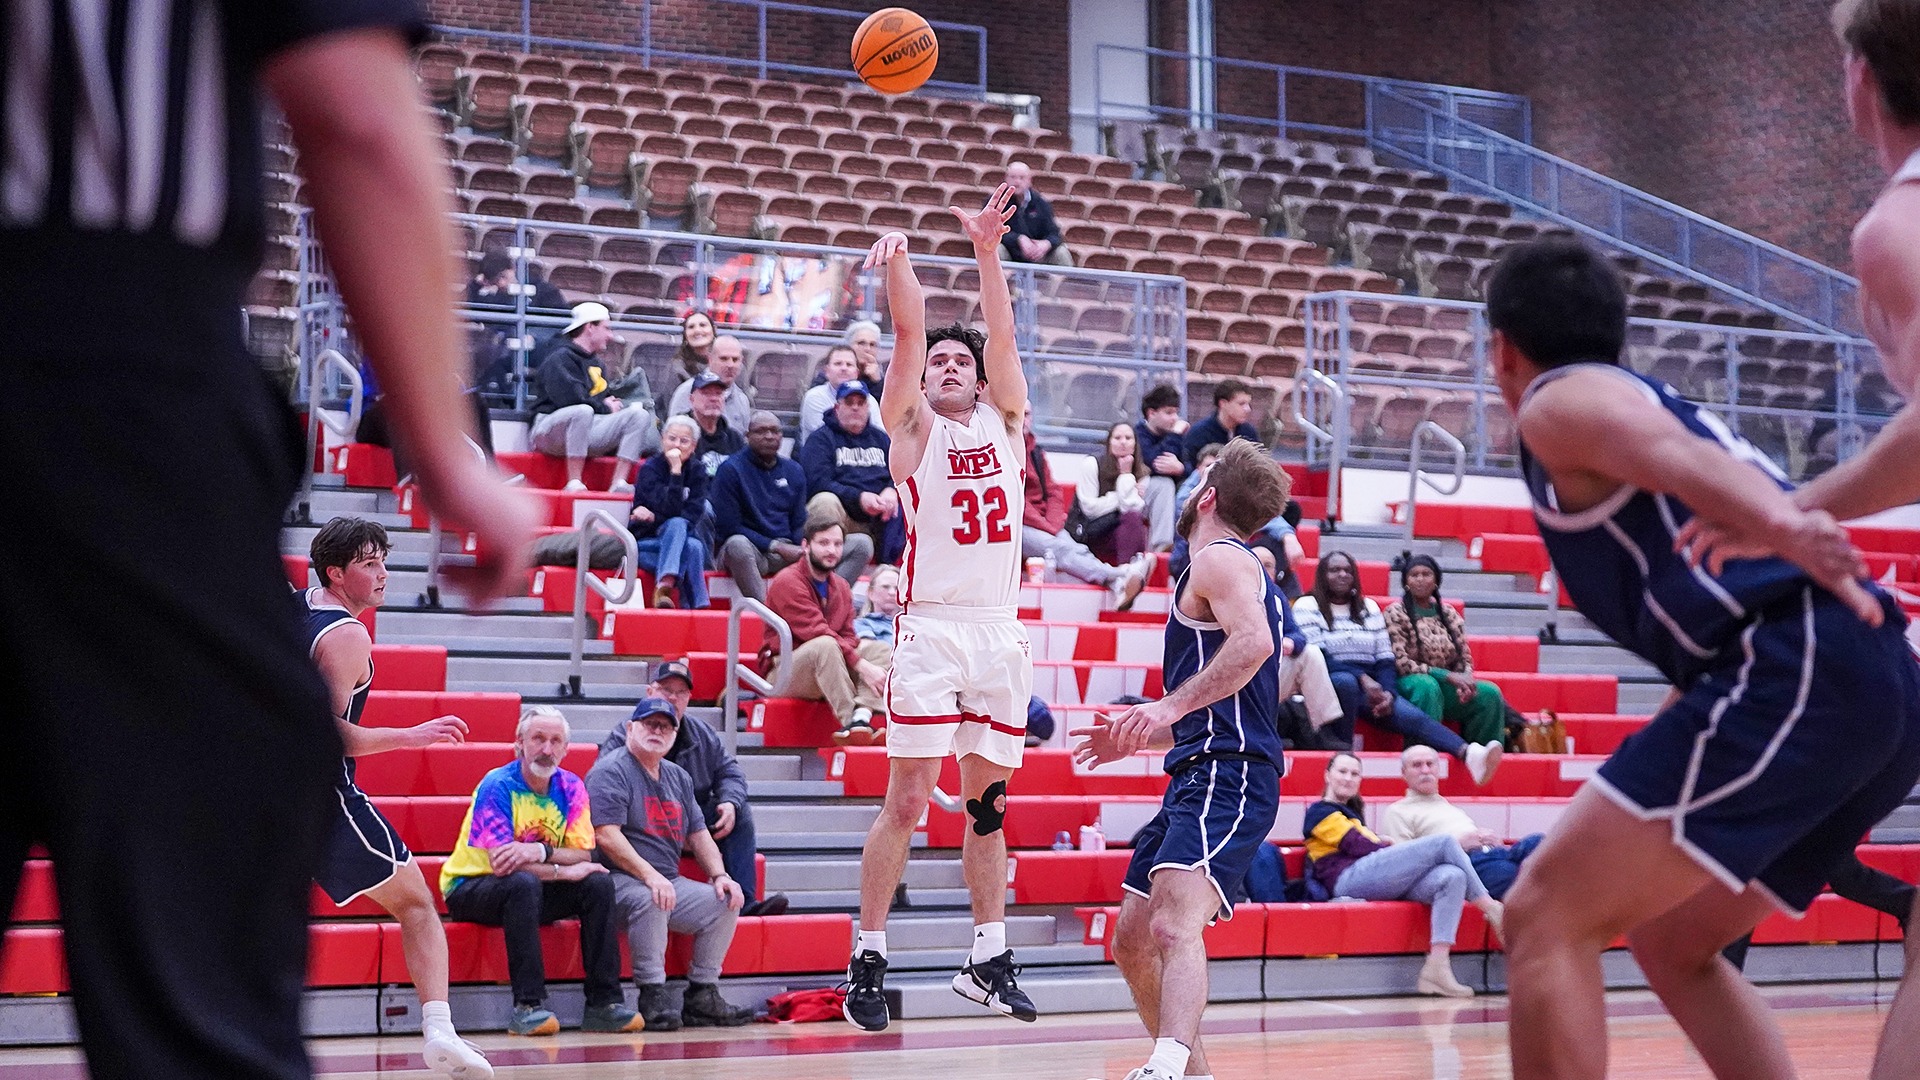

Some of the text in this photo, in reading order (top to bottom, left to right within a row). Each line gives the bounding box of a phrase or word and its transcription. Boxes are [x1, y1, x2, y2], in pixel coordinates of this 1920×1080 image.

[881, 34, 933, 65] Wilson
[947, 447, 1002, 475] WPI
[951, 485, 1012, 546] 32
